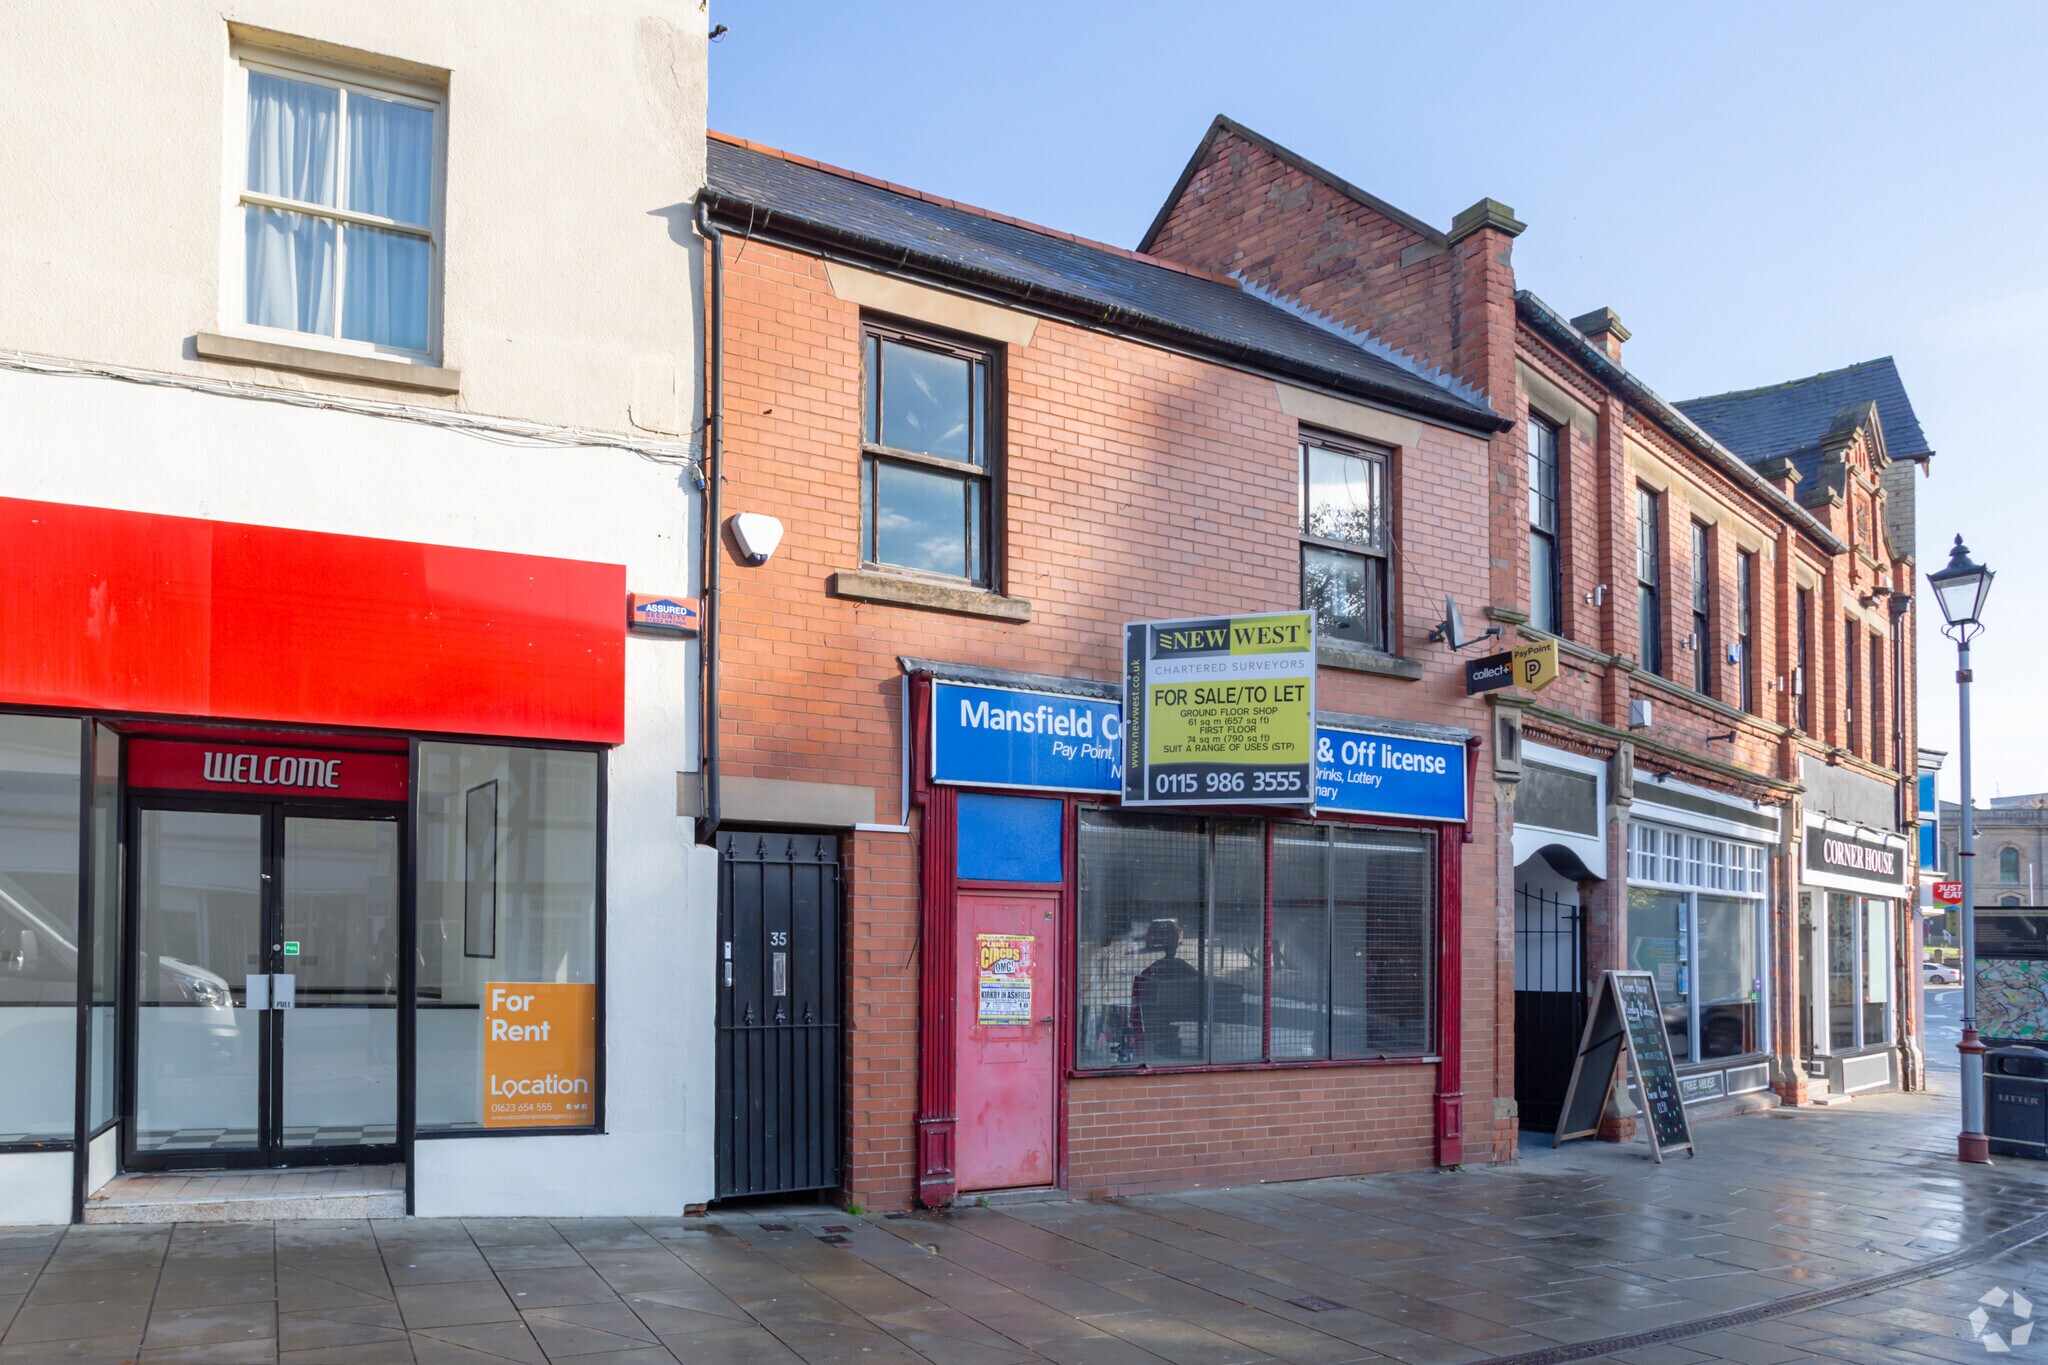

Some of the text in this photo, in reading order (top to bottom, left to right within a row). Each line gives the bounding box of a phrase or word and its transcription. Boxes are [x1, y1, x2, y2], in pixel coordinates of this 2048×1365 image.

[645, 612, 686, 621] SECURITY
[646, 604, 687, 615] ASSURED
[1173, 625, 1301, 650] NEW WEST
[1514, 644, 1552, 659] PayPoint
[1155, 659, 1305, 676] CHARTERED SURVEYORS
[1155, 685, 1305, 706] FOR SALE/TO LET
[1131, 659, 1140, 769] www.newwest.co.uk
[1180, 707, 1278, 717] GROUND FLOOR SHOP
[1188, 718, 1197, 726] 61
[1200, 718, 1210, 726] sq
[1224, 717, 1244, 726] (657
[1246, 718, 1257, 726] sq
[1259, 716, 1270, 725] ft)
[960, 699, 1093, 738] Mansfield
[1316, 737, 1334, 763] &
[1341, 741, 1376, 767] Off
[1381, 743, 1446, 774] license
[1200, 725, 1257, 734] FIRST FLOOR
[1187, 736, 1196, 744] 74
[1224, 734, 1244, 744] (790
[1246, 736, 1257, 744] sq
[1260, 734, 1270, 742] ft)
[1163, 742, 1295, 753] SUIT A RANGE OF USES (STP)
[203, 752, 342, 788] WELCOME
[1052, 741, 1078, 760] Pay
[1081, 744, 1115, 762] Point,
[1347, 770, 1382, 788] Lottery
[1156, 771, 1301, 794] 0115 986 3555
[1823, 838, 1894, 875] CORNER HOUSE
[1938, 884, 1962, 892] JUST
[770, 932, 787, 946] 35
[980, 947, 1020, 970] CIRCUS
[996, 960, 1014, 972] OMG!
[492, 988, 535, 1012] For
[981, 990, 1000, 1000] KIRKBY
[1008, 990, 1030, 1000] ASHFIELD
[492, 1018, 551, 1042] Rent
[491, 1074, 588, 1098] Location
[491, 1102, 552, 1112] 01623 654 555
[1999, 1094, 2039, 1105] LITTER
